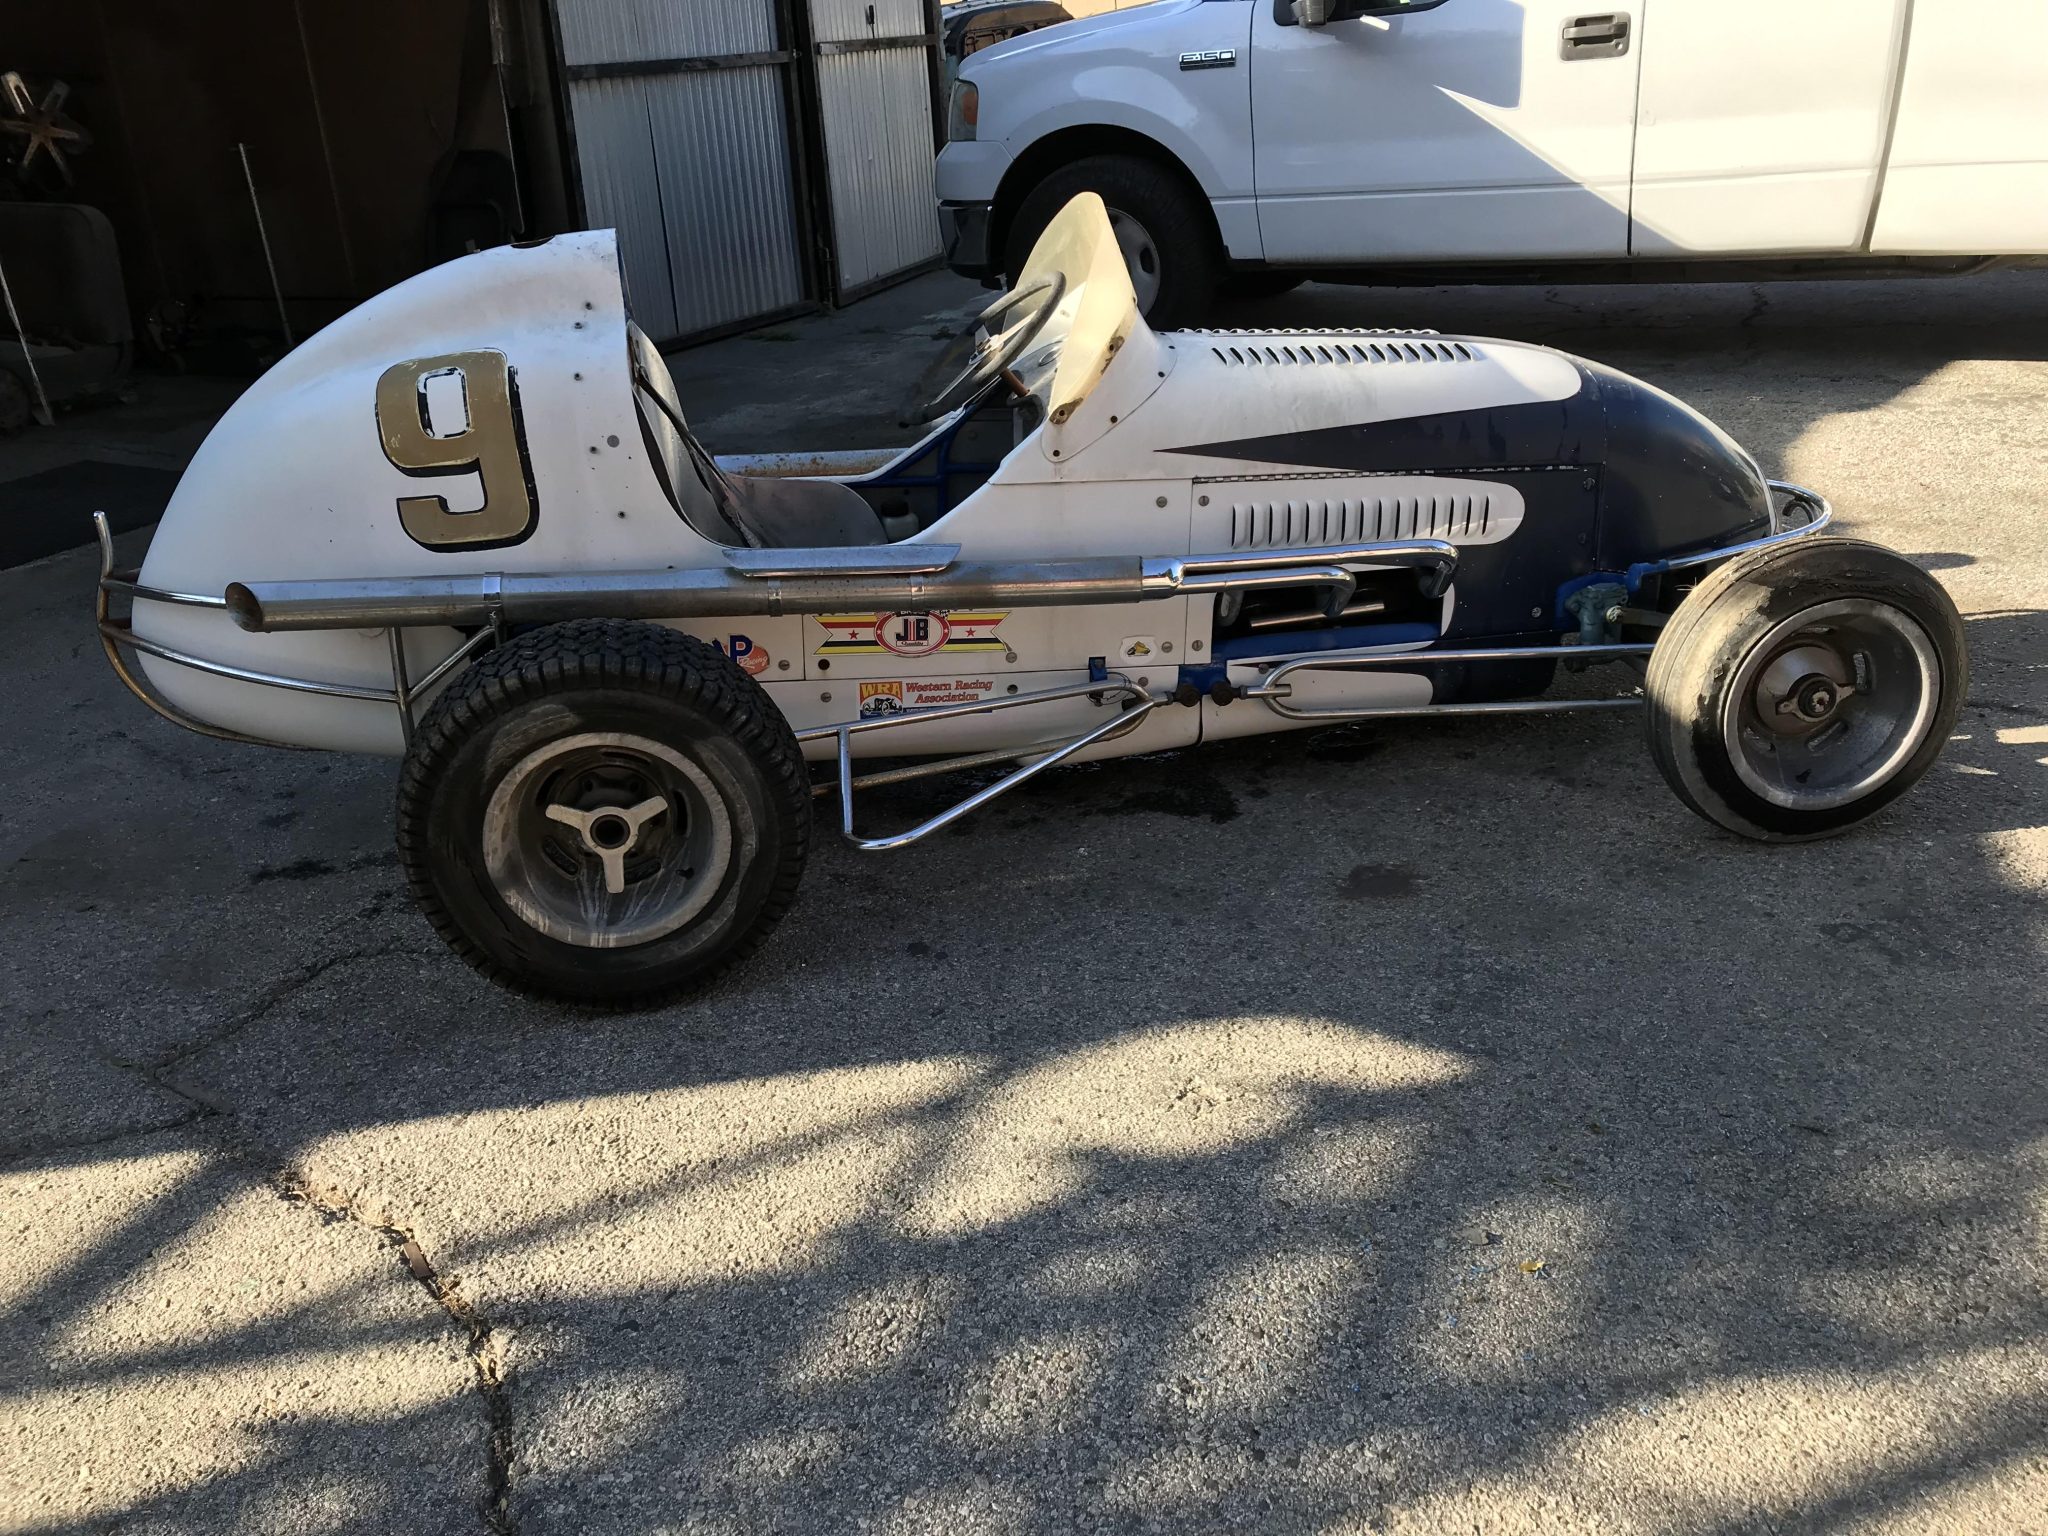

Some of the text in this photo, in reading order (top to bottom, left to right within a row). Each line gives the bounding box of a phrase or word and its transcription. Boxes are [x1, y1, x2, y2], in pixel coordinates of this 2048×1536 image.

[375, 347, 540, 553] 9
[861, 682, 902, 698] WRA
[905, 680, 993, 693] Western Racing
[915, 692, 979, 704] Association
